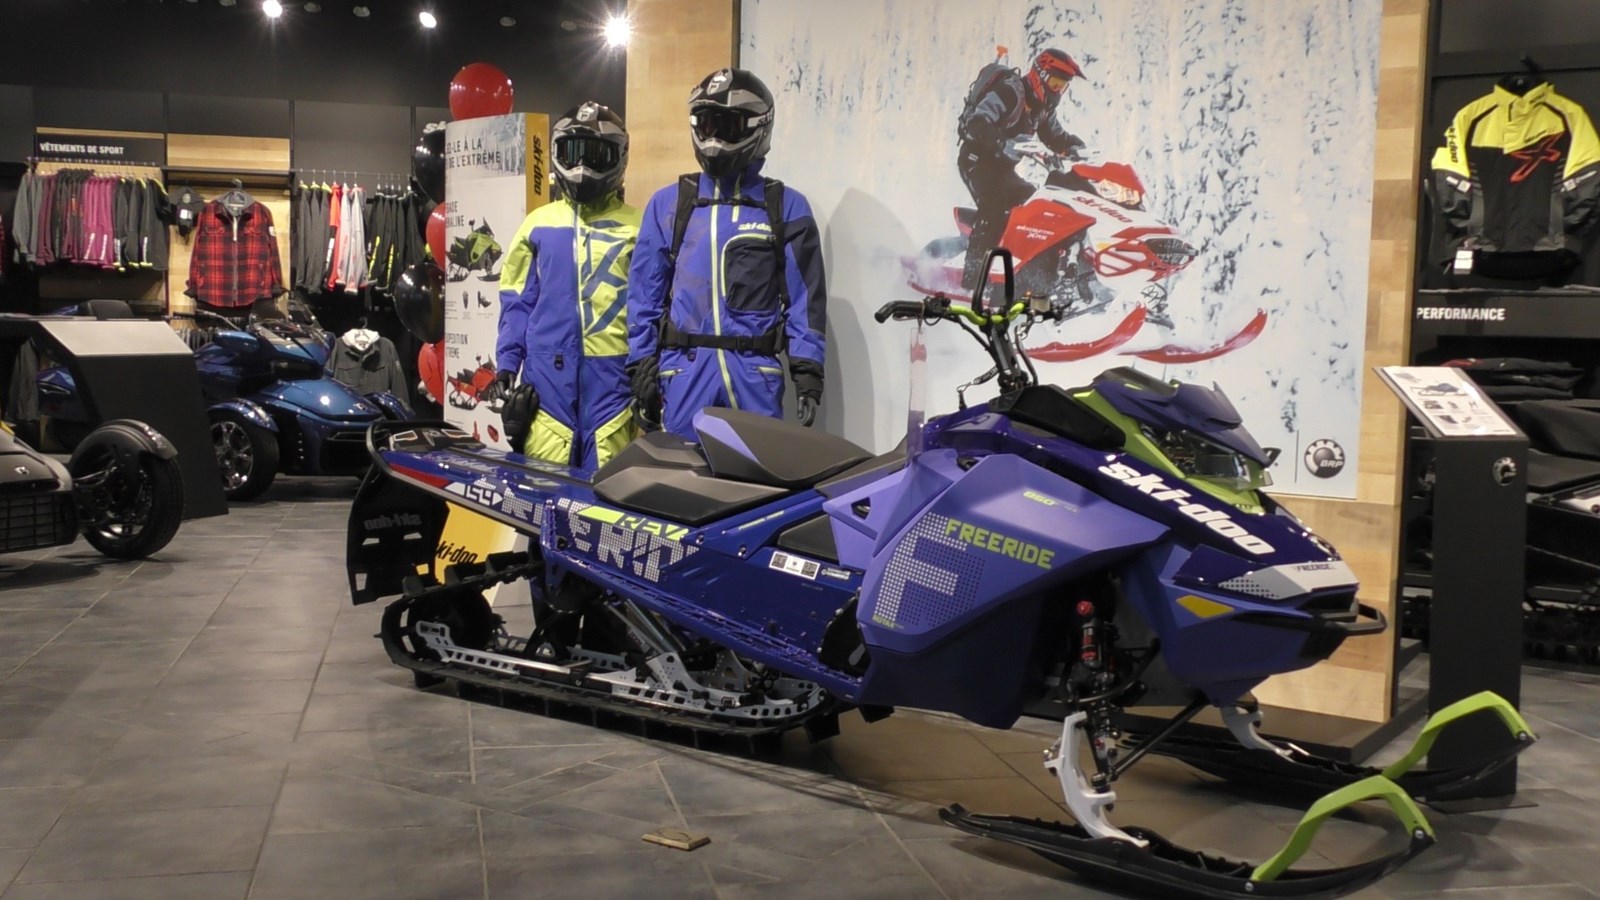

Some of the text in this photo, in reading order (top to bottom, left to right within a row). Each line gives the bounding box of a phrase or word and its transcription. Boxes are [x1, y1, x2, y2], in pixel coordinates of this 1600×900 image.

[40, 142, 124, 154] VÊTEMENTS DE SPORT
[471, 137, 482, 151] LA
[533, 135, 544, 196] ski-doo
[1416, 307, 1506, 321] PERFORMANCE
[1098, 462, 1275, 555] ski-doo
[944, 517, 1056, 570] FREERIDE
